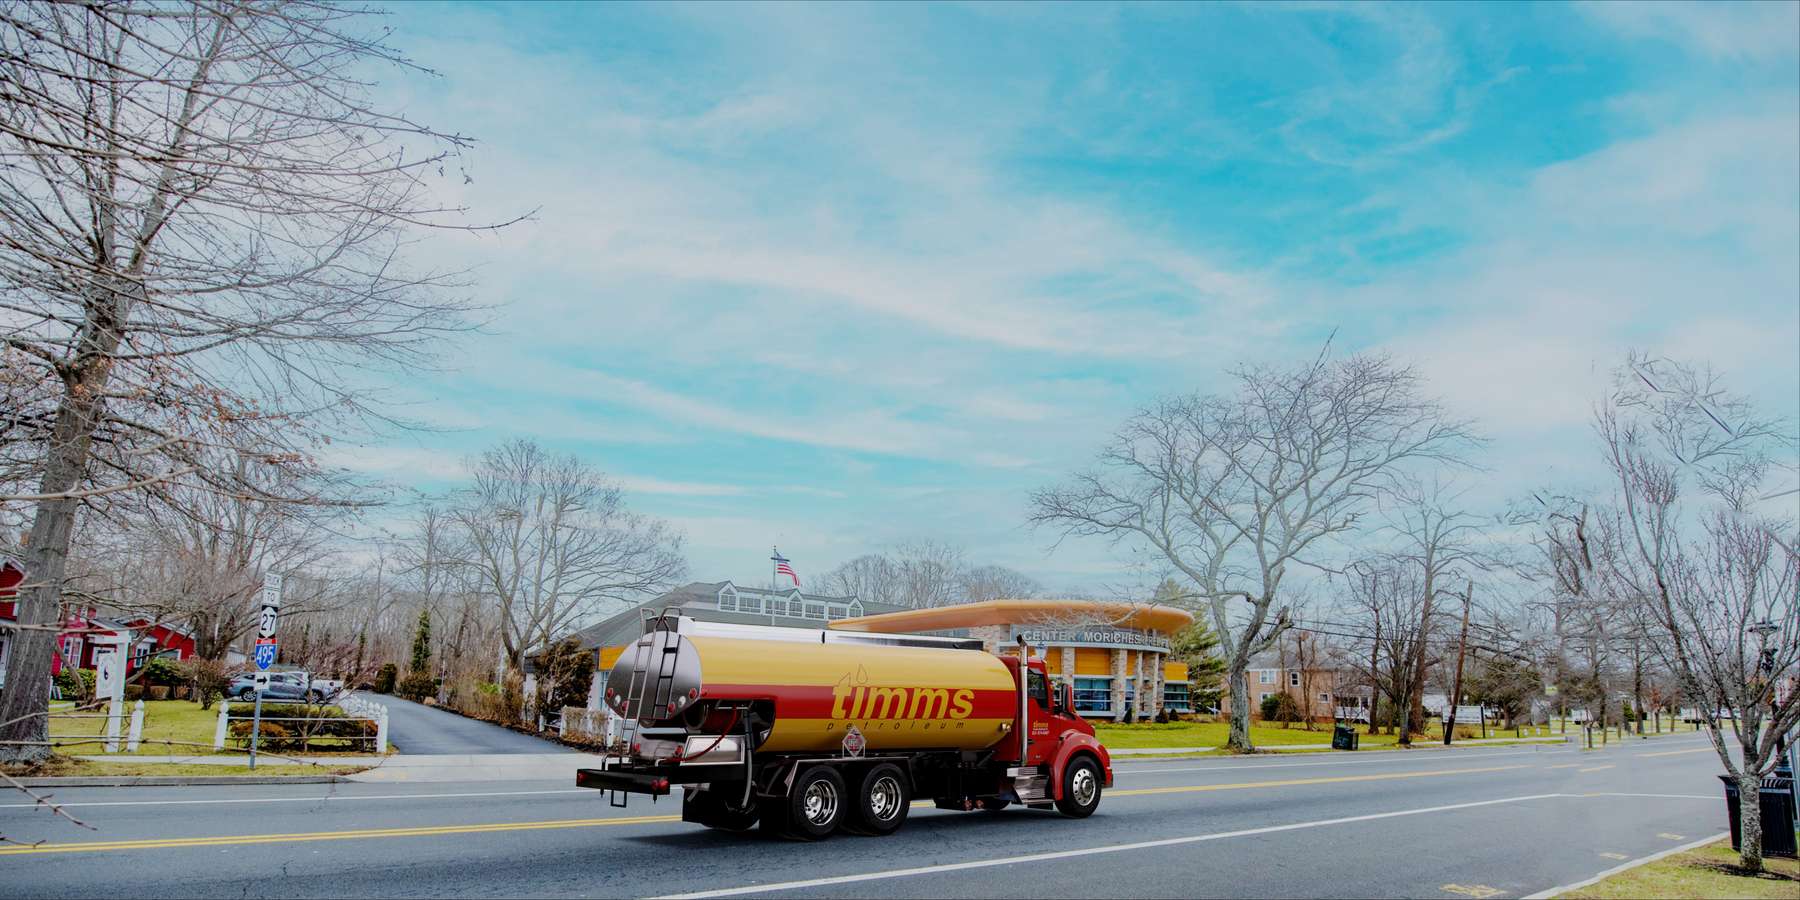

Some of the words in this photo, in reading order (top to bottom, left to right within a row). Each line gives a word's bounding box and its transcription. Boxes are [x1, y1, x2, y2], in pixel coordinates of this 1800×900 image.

[261, 613, 276, 631] 27
[1023, 630, 1076, 641] CENTER
[1084, 631, 1141, 645] MORICHES
[257, 646, 273, 664] 495
[831, 670, 975, 719] timms
[826, 721, 966, 731] petroleum
